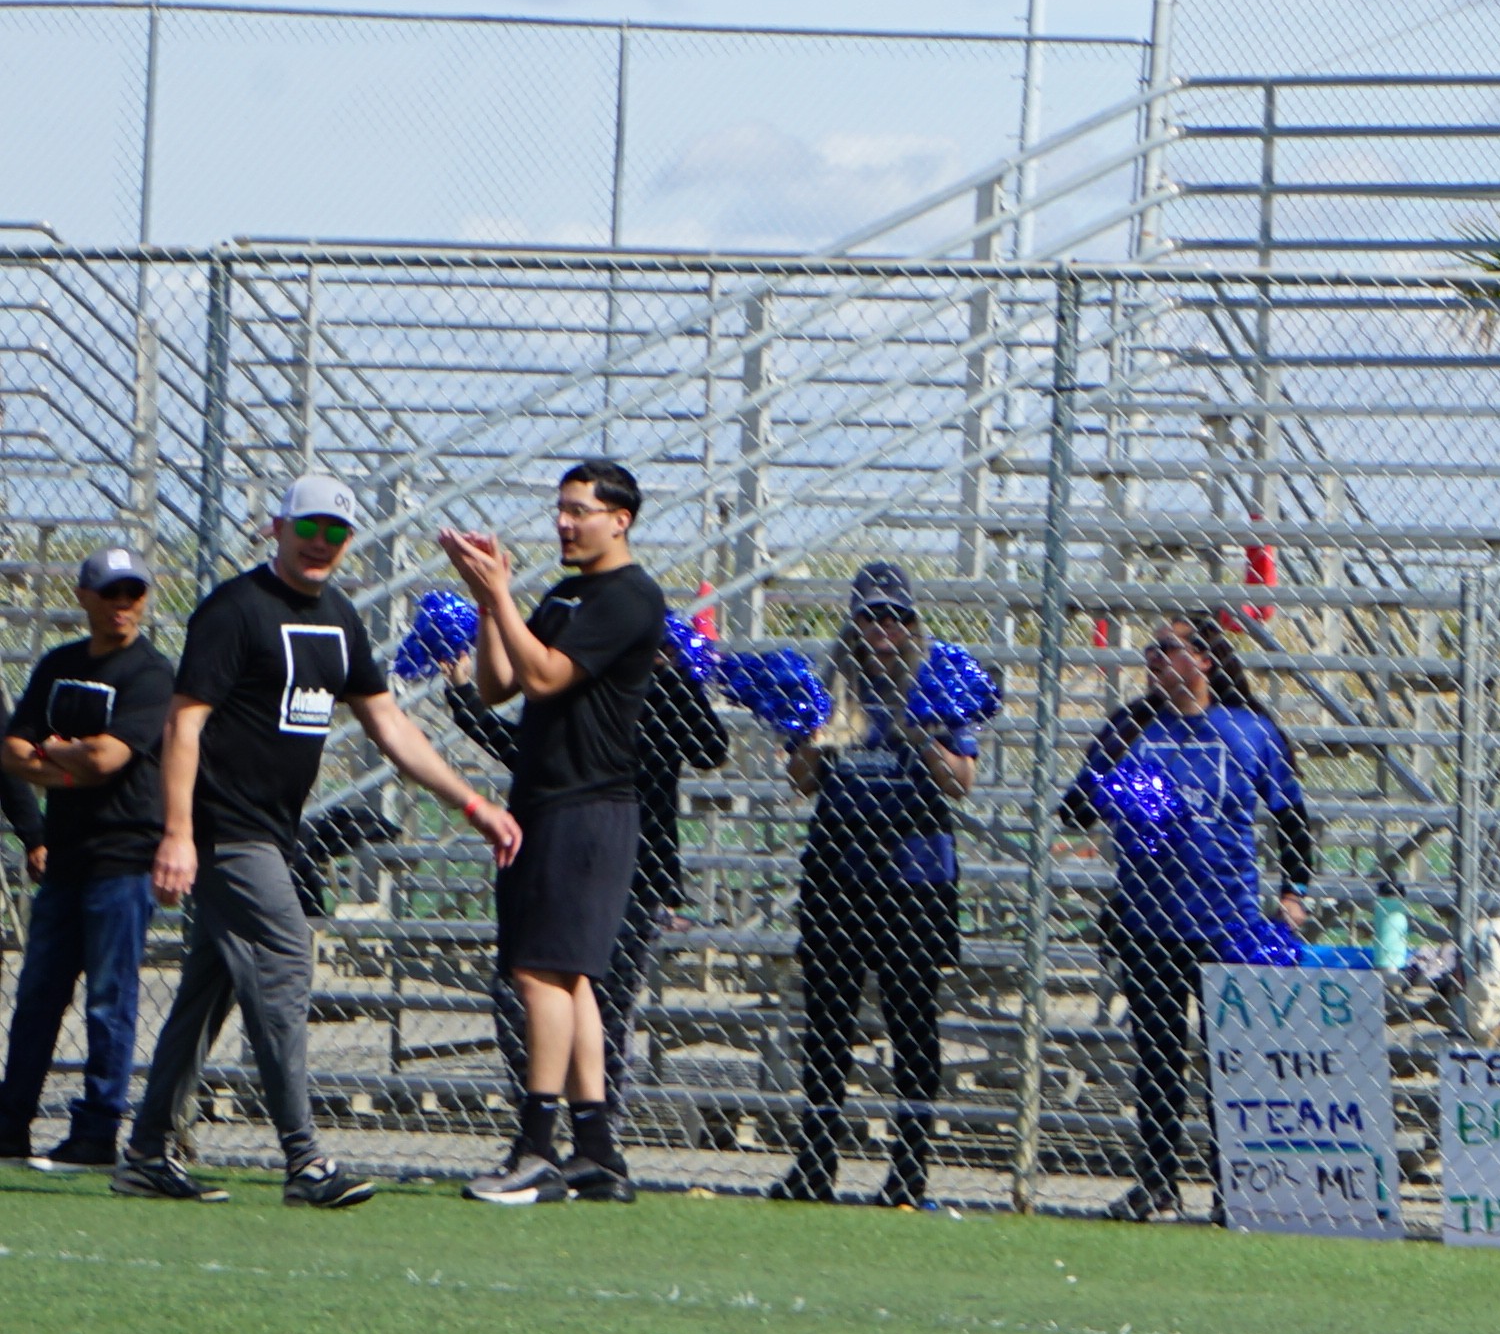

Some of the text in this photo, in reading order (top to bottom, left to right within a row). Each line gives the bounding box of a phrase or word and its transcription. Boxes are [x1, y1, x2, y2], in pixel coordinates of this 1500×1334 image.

[1217, 974, 1353, 1028] AVB
[1216, 1048, 1345, 1079] IS THE
[1226, 1099, 1365, 1134] TEAM
[1231, 1158, 1300, 1193] FOR
